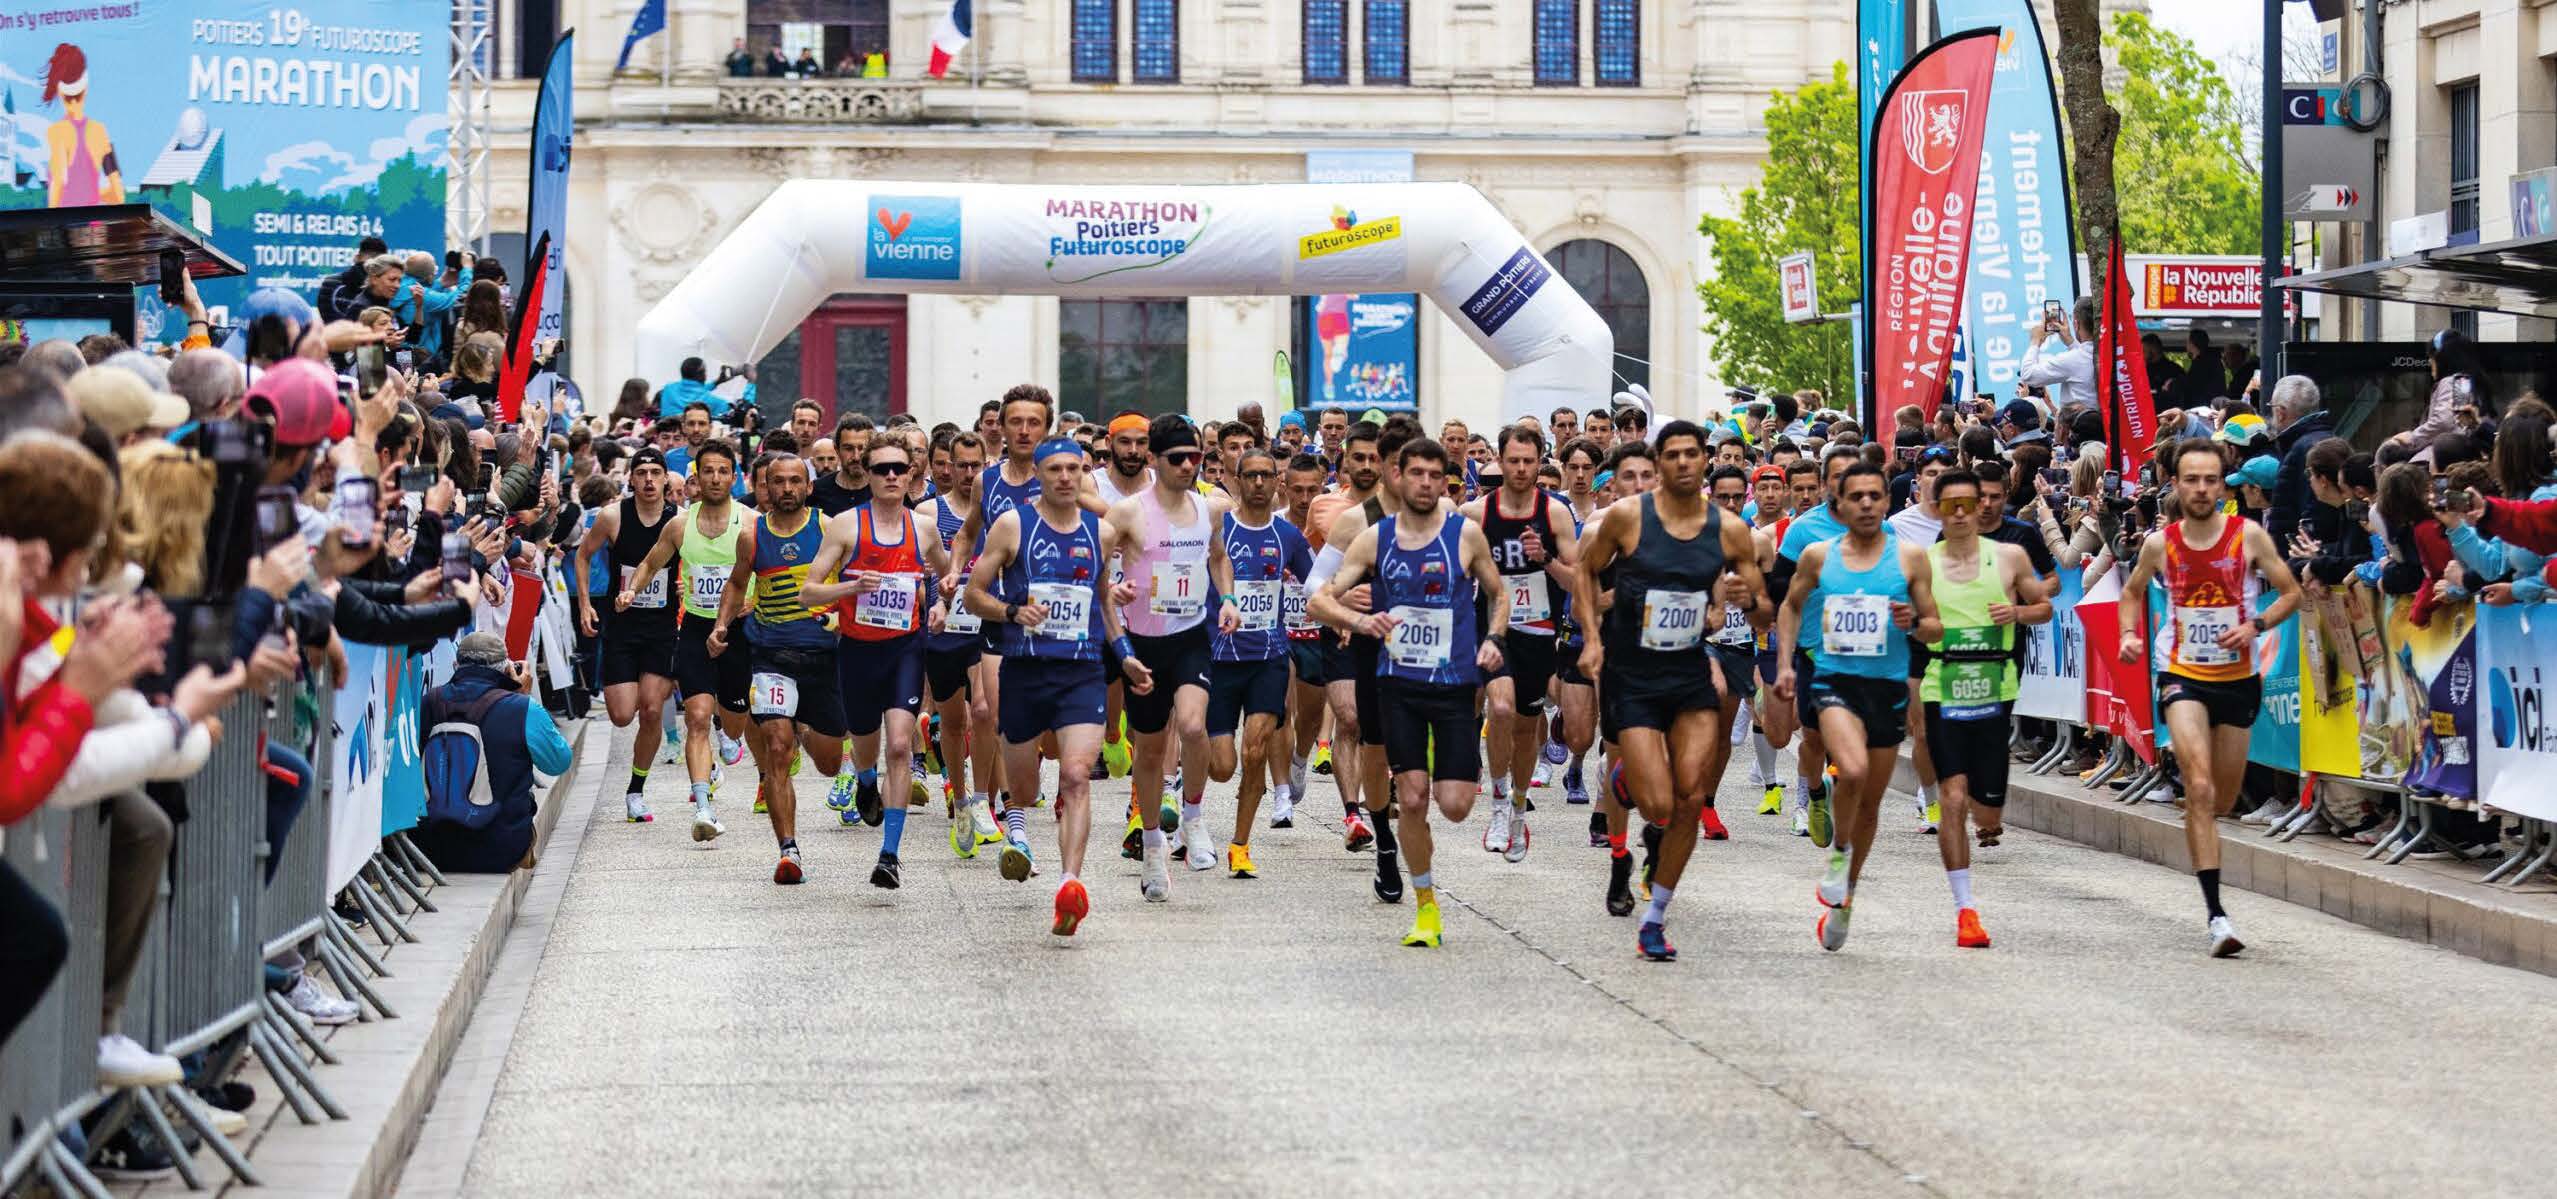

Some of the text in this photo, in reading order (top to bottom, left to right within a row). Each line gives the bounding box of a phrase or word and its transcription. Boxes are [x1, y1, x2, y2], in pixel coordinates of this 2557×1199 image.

[16, 11, 36, 31] s'y
[39, 8, 98, 25] retrouve
[191, 19, 265, 46] POITIERS
[311, 25, 423, 55] FUTUROSCOPE
[188, 53, 421, 112] MARATHON
[1046, 199, 1198, 223] MARATHON
[254, 212, 291, 234] SEMI
[294, 213, 304, 234] &
[307, 214, 358, 236] RELAIS
[373, 216, 384, 236] 4
[1077, 219, 1160, 241] Poitiers
[1050, 236, 1186, 258] Futuroscope
[1307, 223, 1394, 254] futuroscope
[254, 245, 296, 267] TOUT
[874, 243, 955, 261] vienne
[1471, 255, 1532, 314] GRAND POITIERS
[2163, 266, 2262, 288] la Nouvelle
[1888, 254, 1905, 331] RÉGION
[2391, 356, 2432, 367] JCDec
[1160, 540, 1205, 548] SALOMON
[1177, 578, 1189, 597] 11
[1515, 588, 1531, 606] 21
[869, 589, 907, 610] 5035
[1240, 594, 1273, 613] 2059
[1658, 607, 1697, 629] 2001
[1724, 611, 1746, 629] 033
[1834, 610, 1878, 633] 2003
[1399, 623, 1441, 647] 2061
[769, 687, 785, 706] 15
[1951, 677, 1991, 700] 6059
[2508, 665, 2544, 752] ici
